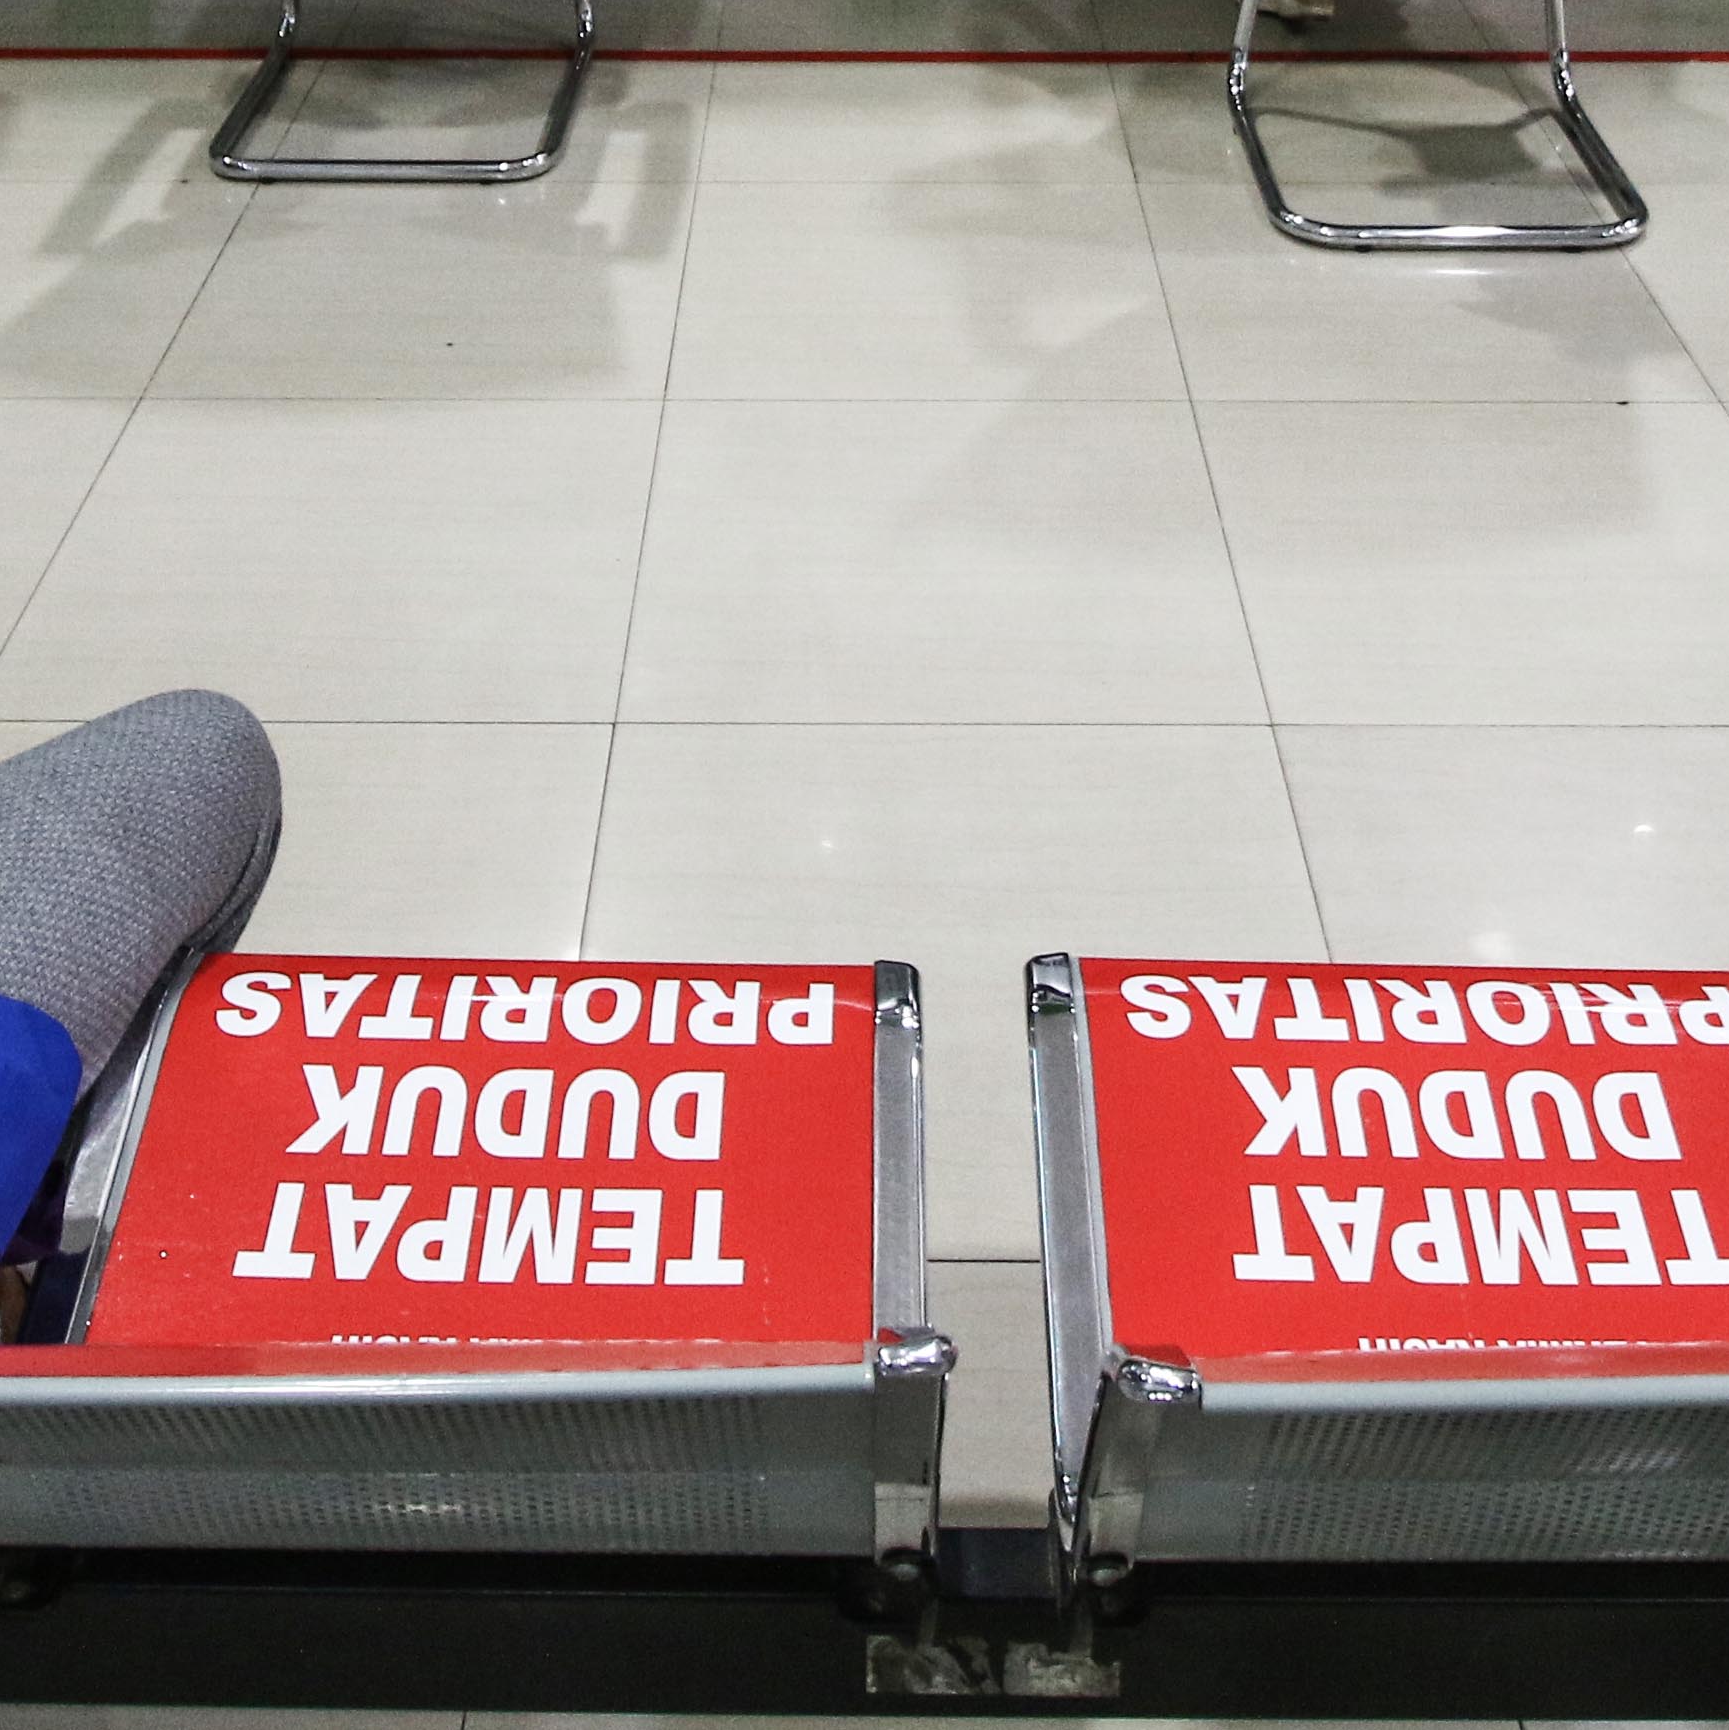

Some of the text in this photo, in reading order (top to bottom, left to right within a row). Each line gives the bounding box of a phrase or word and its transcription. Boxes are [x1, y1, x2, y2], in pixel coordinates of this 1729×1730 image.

[216, 969, 836, 1047] PRIORITAS
[286, 1062, 726, 1162] DUDUK
[1231, 1066, 1683, 1162] DUDUK
[232, 1180, 746, 1287] TEMPAT
